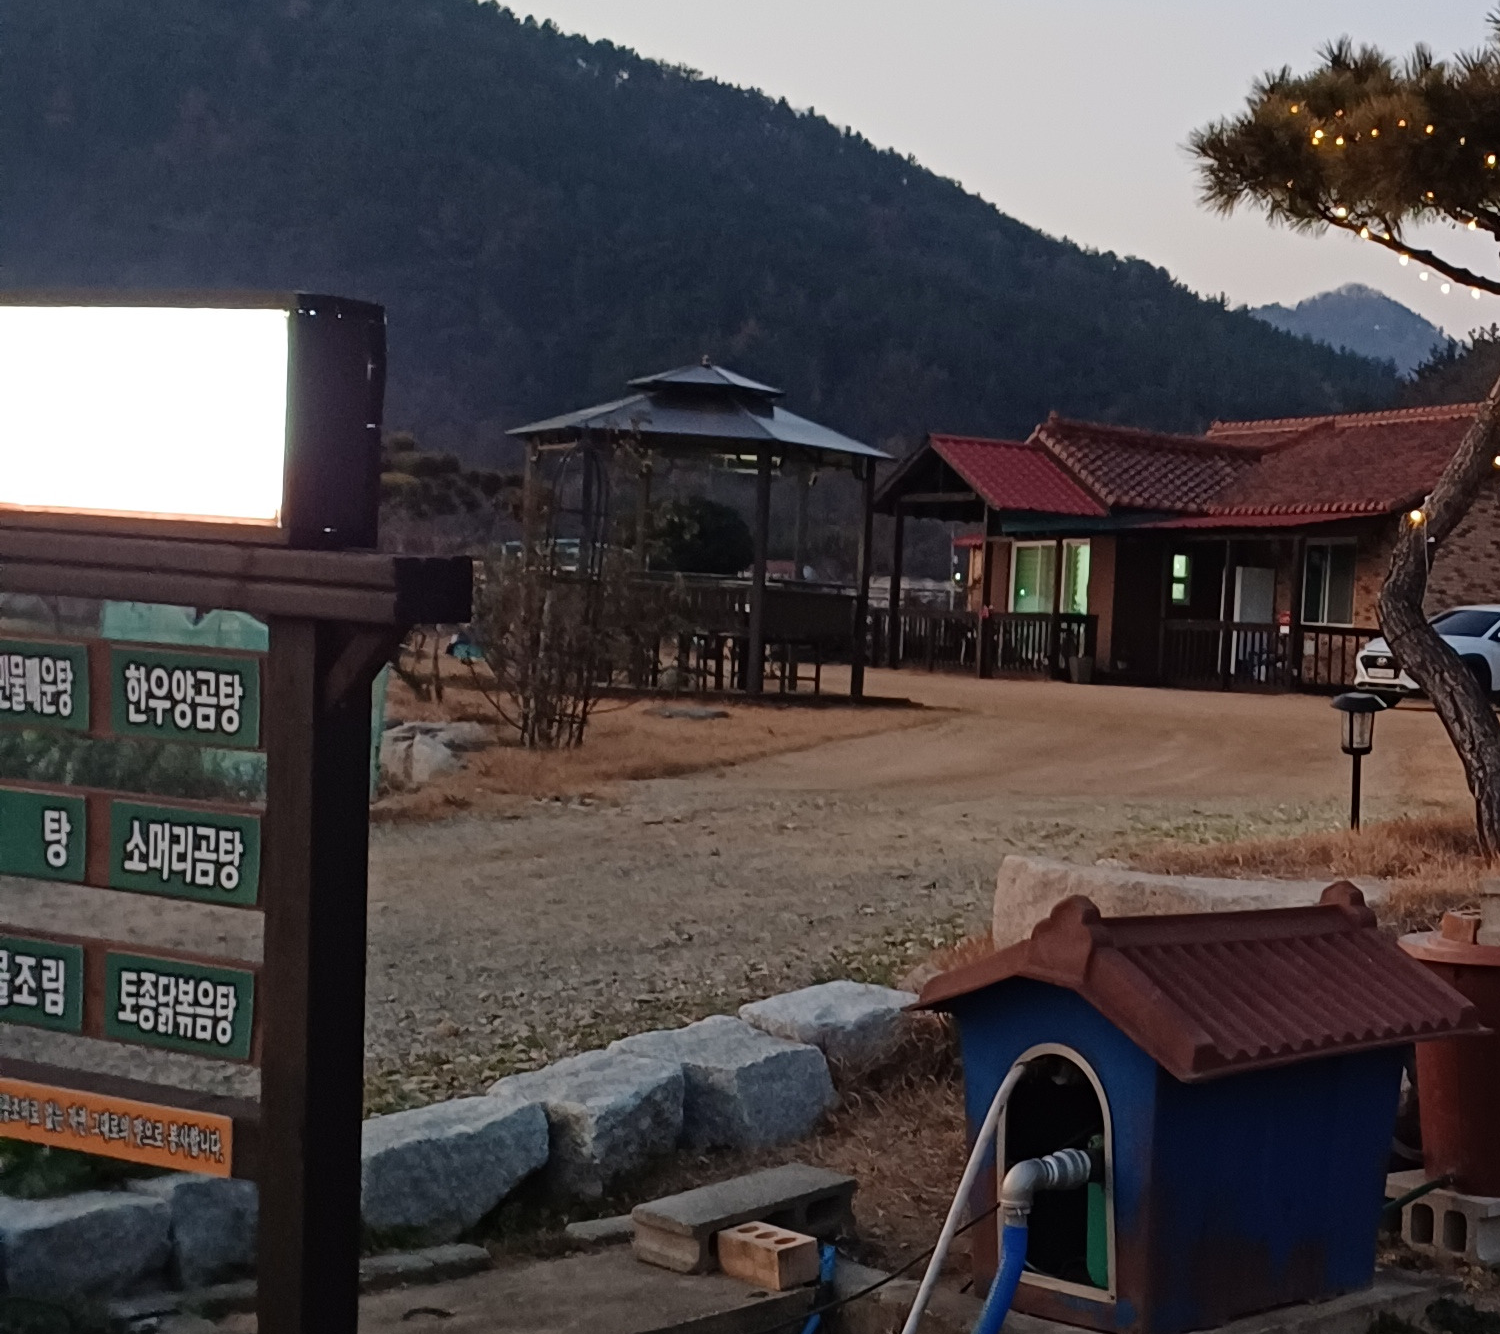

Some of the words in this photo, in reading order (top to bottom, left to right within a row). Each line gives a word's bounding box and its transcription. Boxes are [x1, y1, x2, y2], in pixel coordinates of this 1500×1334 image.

[125, 664, 243, 733] 한우양곰탕
[43, 809, 72, 867] 탕
[124, 820, 243, 889] 소머리곰탕
[118, 971, 236, 1044] 토종닭볶음탕
[91, 1112, 129, 1141] 그대로의
[133, 1118, 164, 1147] 맛으로
[168, 1123, 225, 1161] 봉사합니다.
